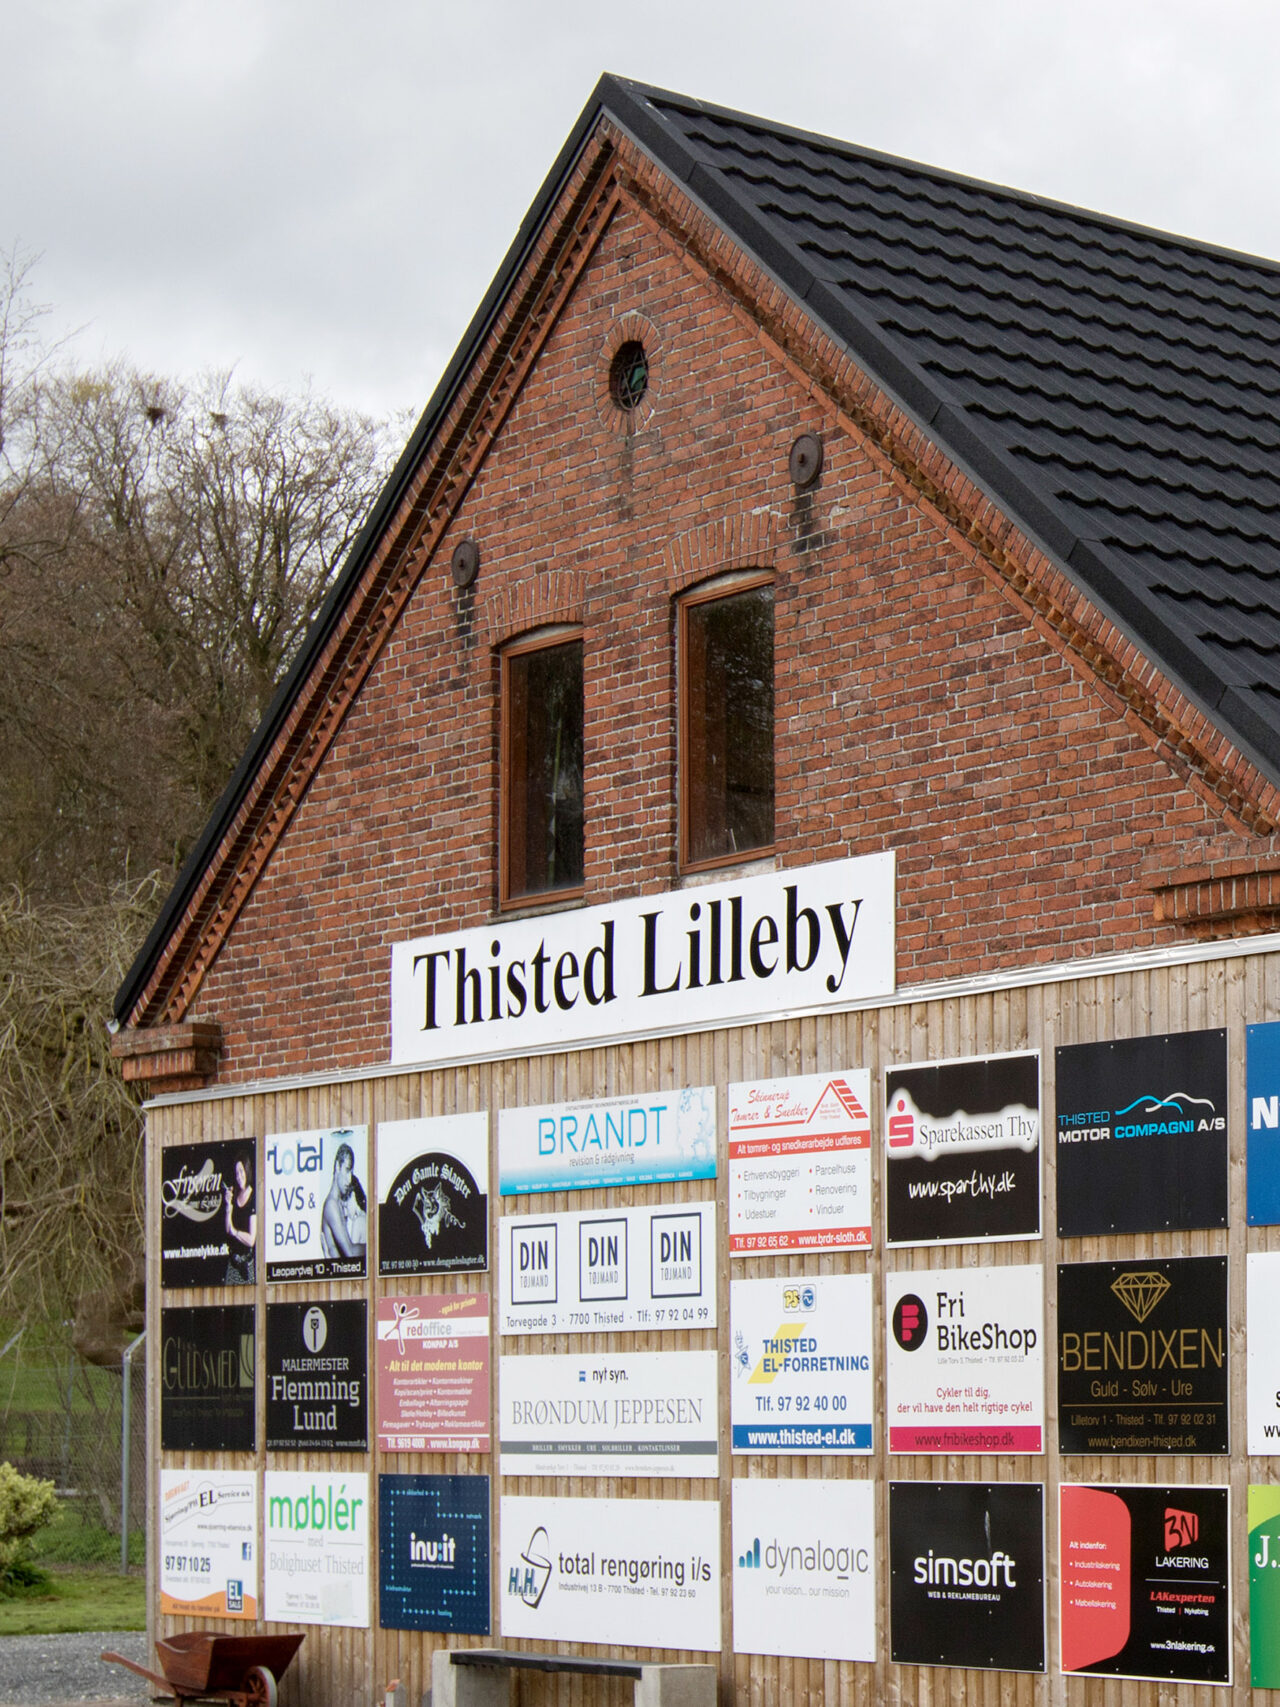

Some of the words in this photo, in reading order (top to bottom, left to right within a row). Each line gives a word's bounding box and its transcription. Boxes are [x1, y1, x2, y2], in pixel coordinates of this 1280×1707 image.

[413, 920, 617, 1031] Thisted
[638, 885, 863, 998] Lilleby
[539, 1106, 667, 1155] BRANDT
[1058, 1111, 1110, 1126] THISTED
[1059, 1127, 1110, 1144] MOTOR
[1115, 1120, 1194, 1138] COMPAGNI
[1197, 1116, 1225, 1132] A/S
[920, 1121, 1004, 1151] Sparekassen
[1007, 1115, 1035, 1143] Thy
[268, 1137, 323, 1176] total
[569, 1156, 593, 1167] revision
[601, 1152, 635, 1165] rådgivning
[394, 1184, 411, 1204] Den
[412, 1162, 440, 1184] Gamle
[440, 1162, 471, 1197] Slagter
[909, 1169, 1016, 1203] www.sparthy.dk
[271, 1186, 304, 1211] VVS
[309, 1193, 315, 1208] &
[274, 1221, 310, 1246] BAD
[660, 1230, 692, 1262] DIN
[735, 1237, 745, 1248] Tlf.
[747, 1236, 755, 1247] 97
[757, 1236, 765, 1247] 92
[767, 1235, 776, 1246] 65
[778, 1234, 788, 1246] 62
[798, 1233, 868, 1246] www.brdr-sloth.dk
[163, 1244, 229, 1259] www.hannelykke.dk
[520, 1240, 548, 1271] DIN
[589, 1236, 618, 1266] DIN
[272, 1266, 313, 1277] Leopardvej
[315, 1264, 324, 1274] 10
[332, 1261, 360, 1272] Thisted
[520, 1274, 548, 1289] TØJMAND
[589, 1270, 618, 1285] TØJMAND
[660, 1266, 692, 1282] TØJMAND
[937, 1291, 965, 1318] Fri
[407, 1323, 451, 1336] redoffice
[937, 1324, 1037, 1355] BikeShop
[763, 1338, 817, 1353] THISTED
[1062, 1328, 1223, 1372] BENDIXEN
[282, 1358, 349, 1371] MALERMESTER
[592, 1369, 608, 1383] nyt
[610, 1369, 628, 1383] syn.
[763, 1355, 869, 1373] EL-FORRETNING
[272, 1375, 360, 1407] Flemming
[936, 1387, 963, 1399] Cykler
[965, 1387, 974, 1398] til
[976, 1387, 990, 1400] dig,
[1091, 1380, 1119, 1397] Guld
[1133, 1380, 1157, 1397] Sølv
[1171, 1379, 1192, 1395] Ure
[293, 1405, 337, 1431] Lund
[512, 1399, 607, 1425] BRØNDUM
[614, 1398, 702, 1430] JEPPESEN
[898, 1402, 910, 1414] der
[912, 1402, 921, 1413] vil
[923, 1402, 942, 1413] have
[945, 1402, 960, 1412] den
[963, 1401, 979, 1412] helt
[981, 1401, 1008, 1416] rigtige
[1011, 1400, 1032, 1414] cykel
[748, 1426, 855, 1446] www.thisted-el.dk
[915, 1431, 1015, 1448] www.fribikeshop.dk
[1088, 1434, 1196, 1448] www.bendixen-thisted.dk
[269, 1484, 363, 1531] møblér
[410, 1532, 455, 1562] inu:it
[765, 1539, 868, 1577] dynalogic
[270, 1552, 322, 1576] Bolighuset
[326, 1555, 364, 1575] Thisted
[559, 1552, 595, 1576] total
[601, 1554, 685, 1586] rengøring
[691, 1556, 711, 1581] i/s
[914, 1549, 1016, 1588] simsoft
[1155, 1556, 1208, 1569] LAKERING
[509, 1567, 538, 1596] H.H.
[1150, 1591, 1215, 1604] LAKexperten
[1150, 1639, 1215, 1654] www.3nlakering.dk
